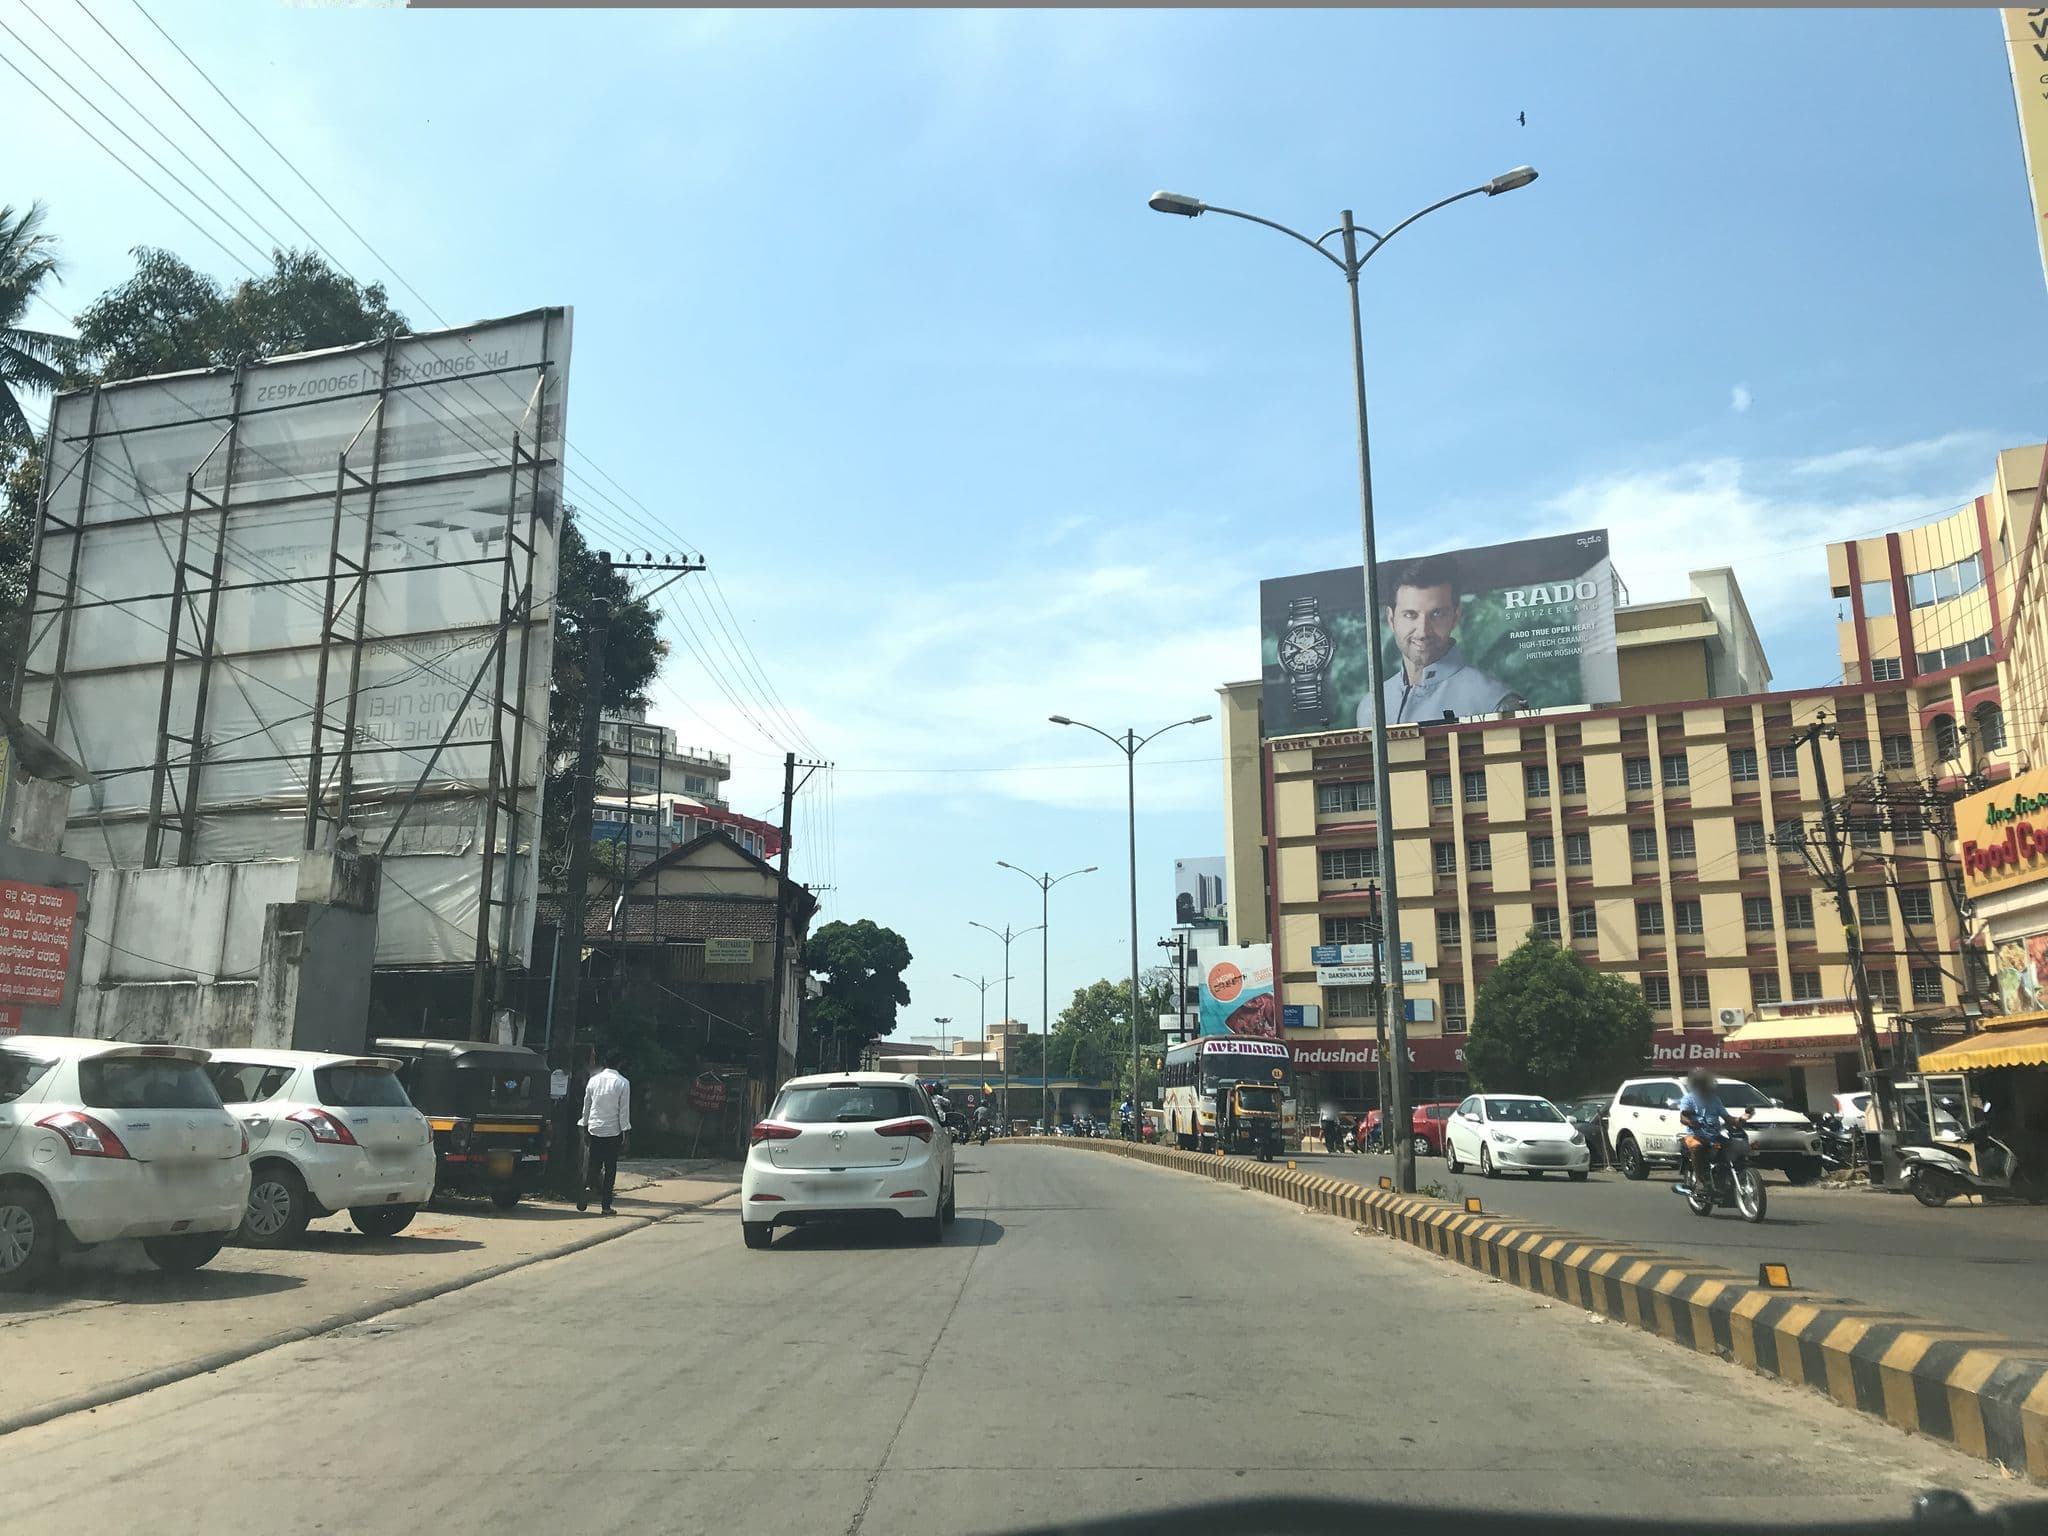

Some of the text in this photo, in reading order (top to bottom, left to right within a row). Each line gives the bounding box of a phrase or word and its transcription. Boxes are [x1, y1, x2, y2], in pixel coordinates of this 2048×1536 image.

[1504, 581, 1598, 610] RADO
[1505, 603, 1598, 621] SWITZERLAND
[1510, 622, 1596, 639] RADO TRUE OPEN HEART
[1519, 639, 1556, 649] HIGH-TECH
[1554, 647, 1583, 657] ROSHAN
[1962, 821, 2048, 877] Food Co
[1208, 1042, 1287, 1056] AVE MARIA
[1294, 1047, 1416, 1063] IndusInd Bk
[1644, 1043, 1686, 1060] Ind
